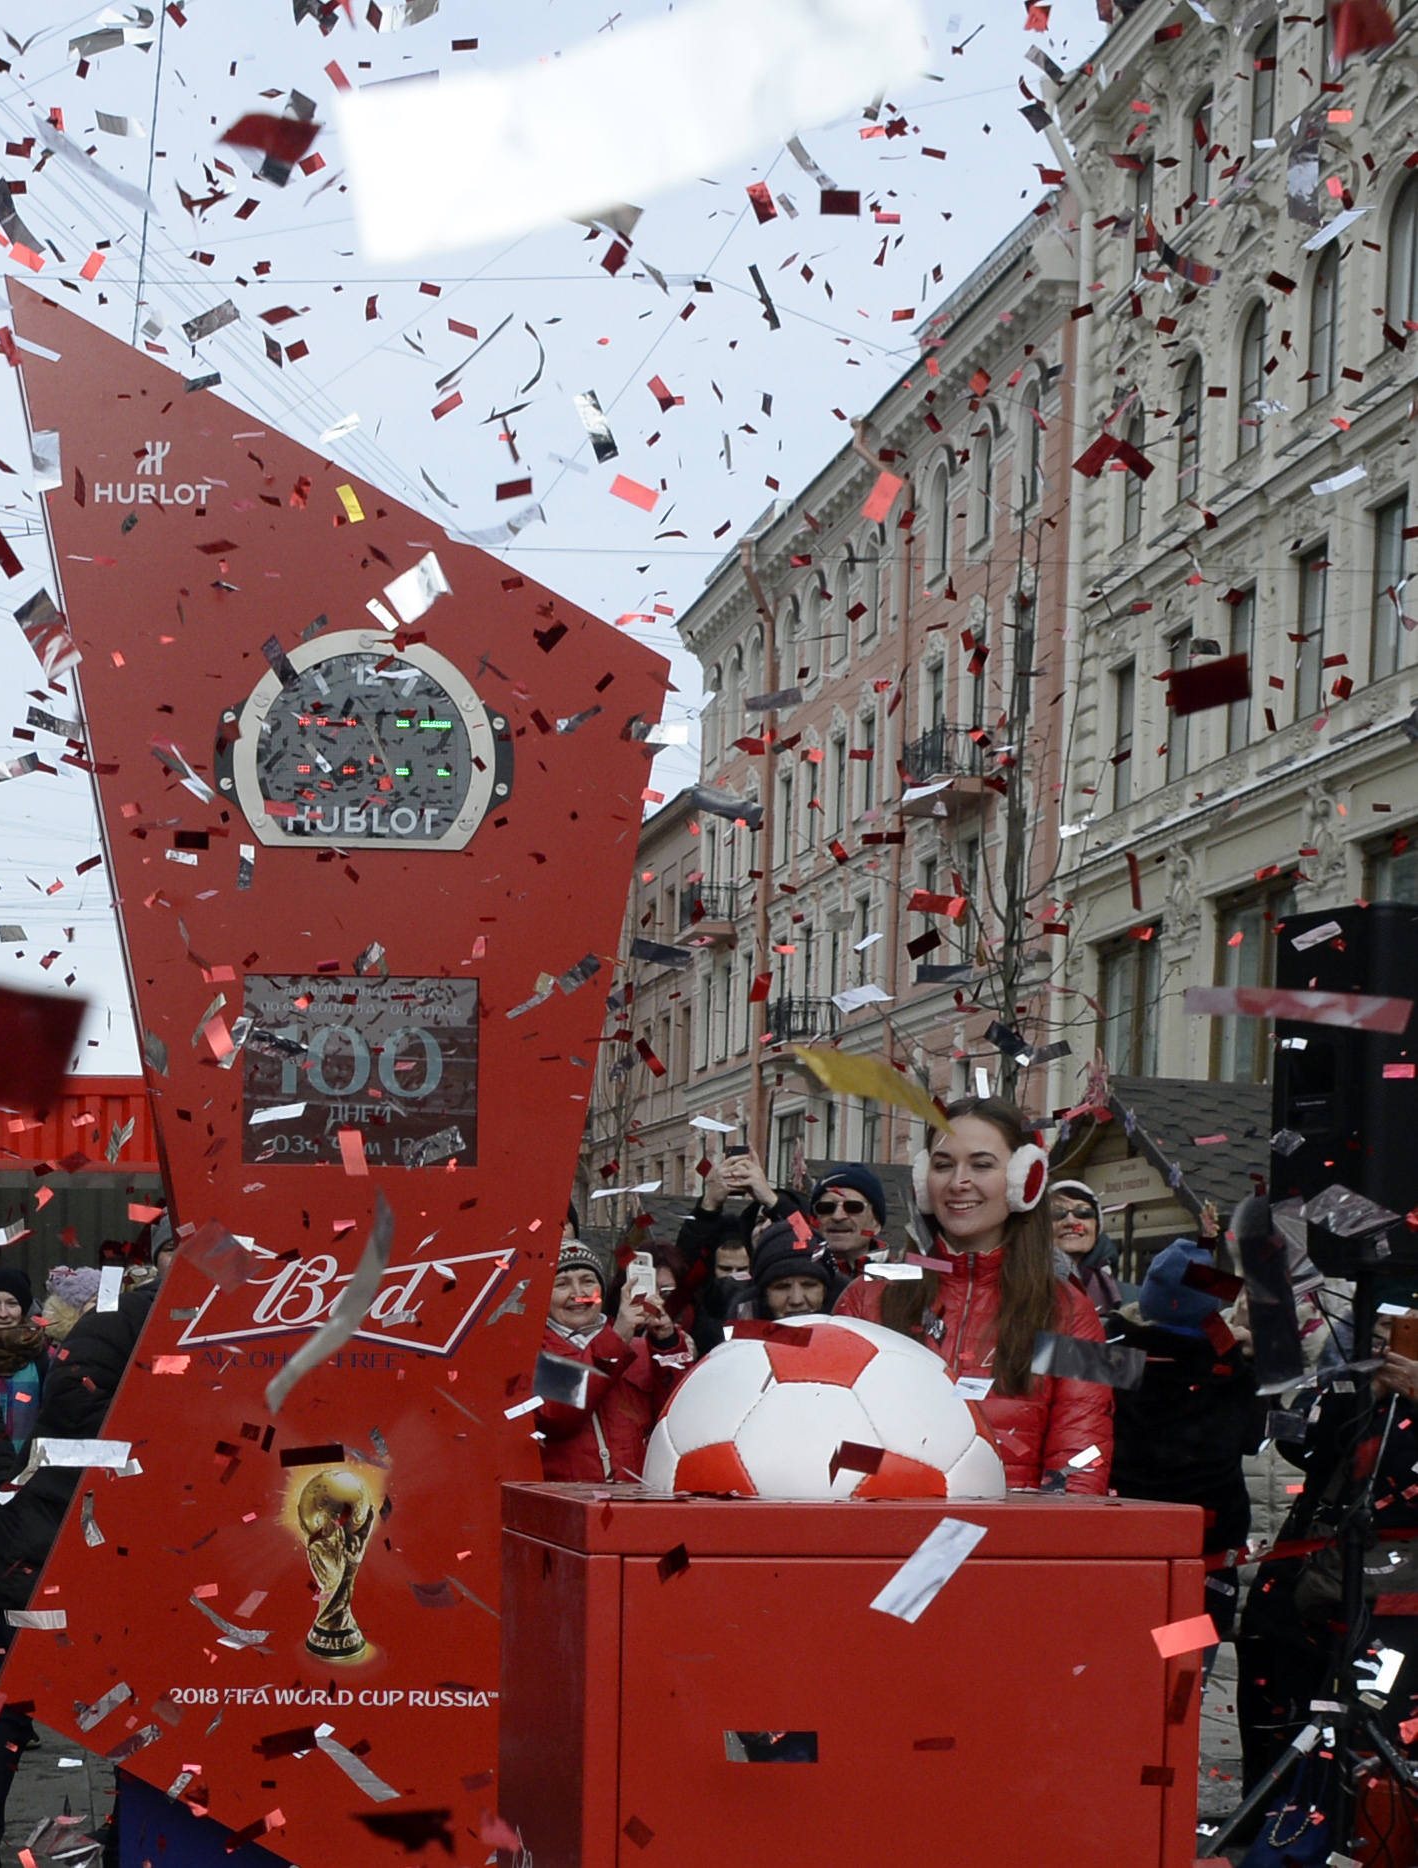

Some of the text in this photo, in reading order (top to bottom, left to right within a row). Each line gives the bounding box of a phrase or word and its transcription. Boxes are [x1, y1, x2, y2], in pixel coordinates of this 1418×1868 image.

[94, 482, 212, 505] HUBLOT
[288, 805, 440, 835] HUBLOT
[274, 1024, 443, 1098] 100
[327, 1101, 392, 1124] ДНЕЙ
[336, 1353, 402, 1370] FREE
[169, 1687, 219, 1705] 2018
[225, 1688, 270, 1705] FIFA
[274, 1689, 354, 1706] WORLD
[359, 1690, 403, 1706] CUP
